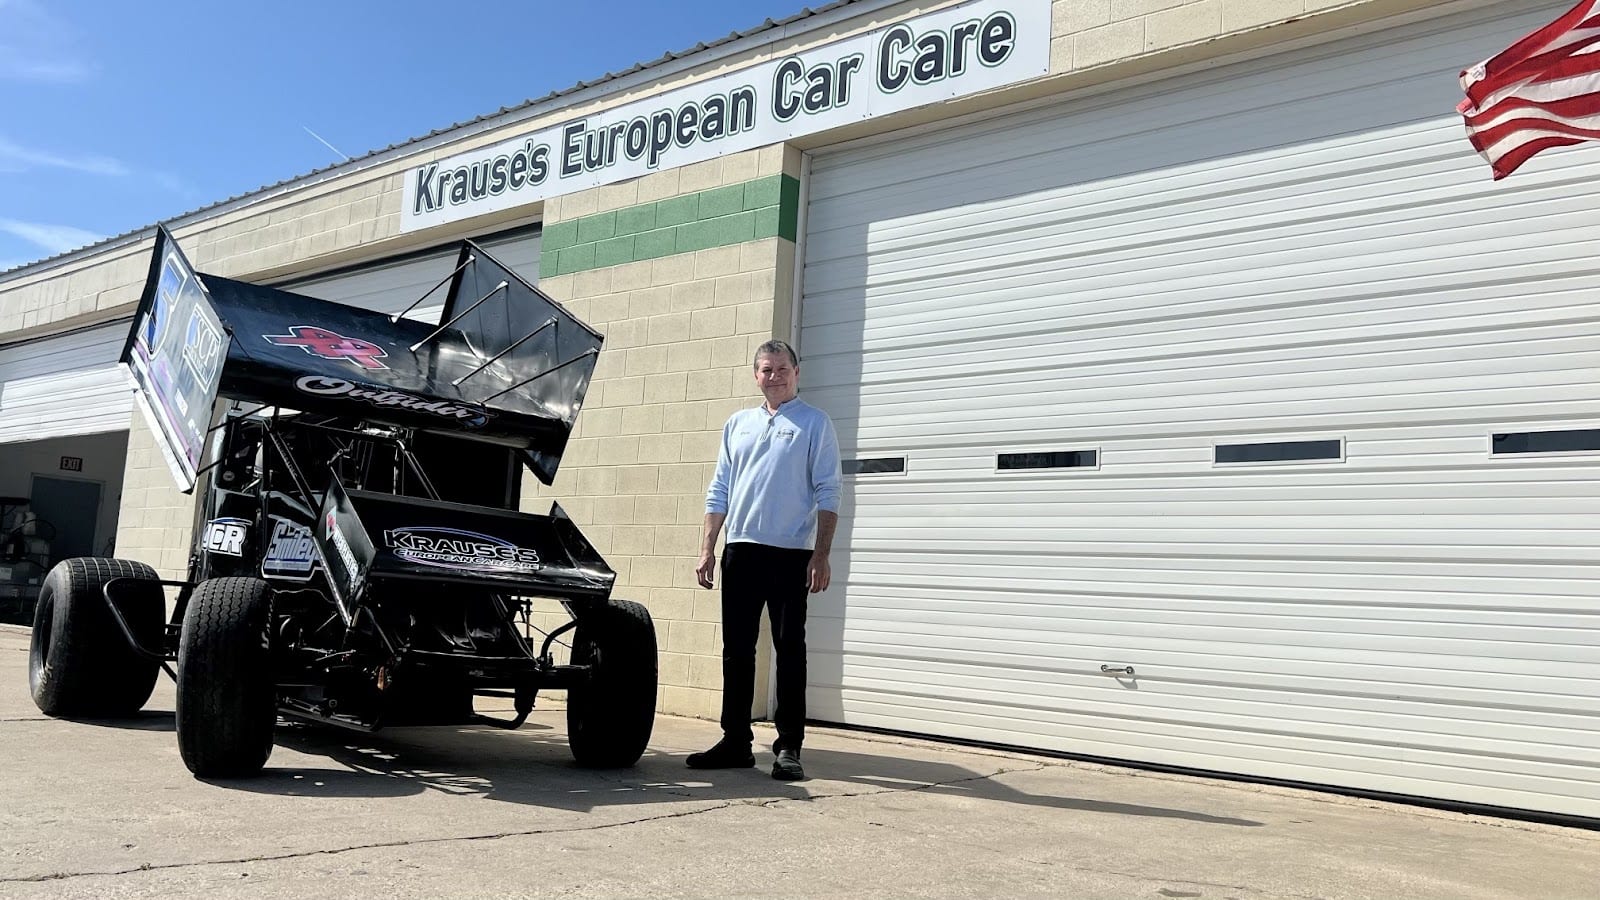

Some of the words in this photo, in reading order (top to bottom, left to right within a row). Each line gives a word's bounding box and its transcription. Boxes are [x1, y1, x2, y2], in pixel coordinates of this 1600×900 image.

[414, 139, 550, 214] Krause's
[560, 85, 756, 178] European
[772, 54, 863, 122] Car
[877, 11, 1016, 94] Care
[63, 457, 81, 470] EXIT
